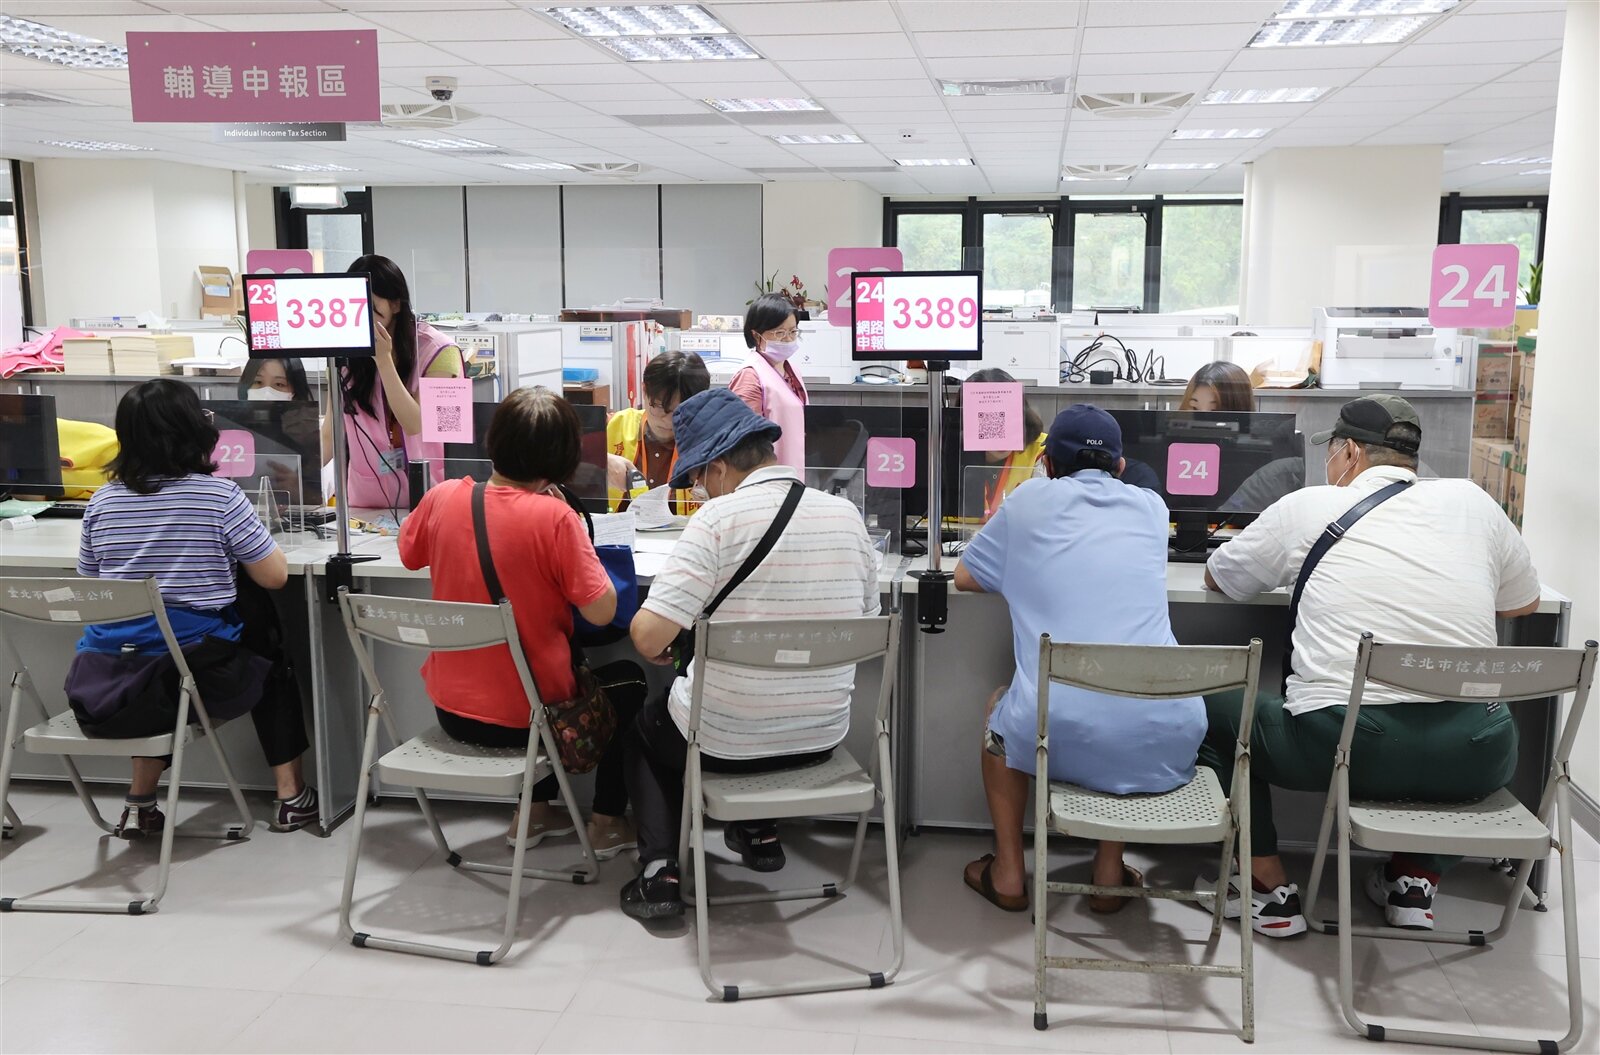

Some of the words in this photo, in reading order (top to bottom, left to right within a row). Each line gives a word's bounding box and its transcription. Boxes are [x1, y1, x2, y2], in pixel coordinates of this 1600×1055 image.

[163, 65, 347, 98] 輔導申報區
[224, 129, 259, 137] Individual
[260, 129, 287, 137] Income
[288, 129, 300, 137] Tax
[300, 129, 327, 137] Section
[248, 284, 276, 304] 23
[857, 281, 884, 303] 24
[1438, 264, 1510, 308] 24
[286, 298, 368, 329] 3387
[892, 297, 978, 329] 3389
[251, 320, 279, 335] 網路
[856, 320, 884, 335] 網路
[253, 335, 281, 349] 申報
[857, 336, 884, 350] 申報
[220, 444, 245, 463] 22
[877, 453, 905, 473] 23
[1178, 459, 1208, 479] 24
[7, 586, 114, 602] 臺北市區公所
[1400, 653, 1543, 675] 臺北市信義區公所
